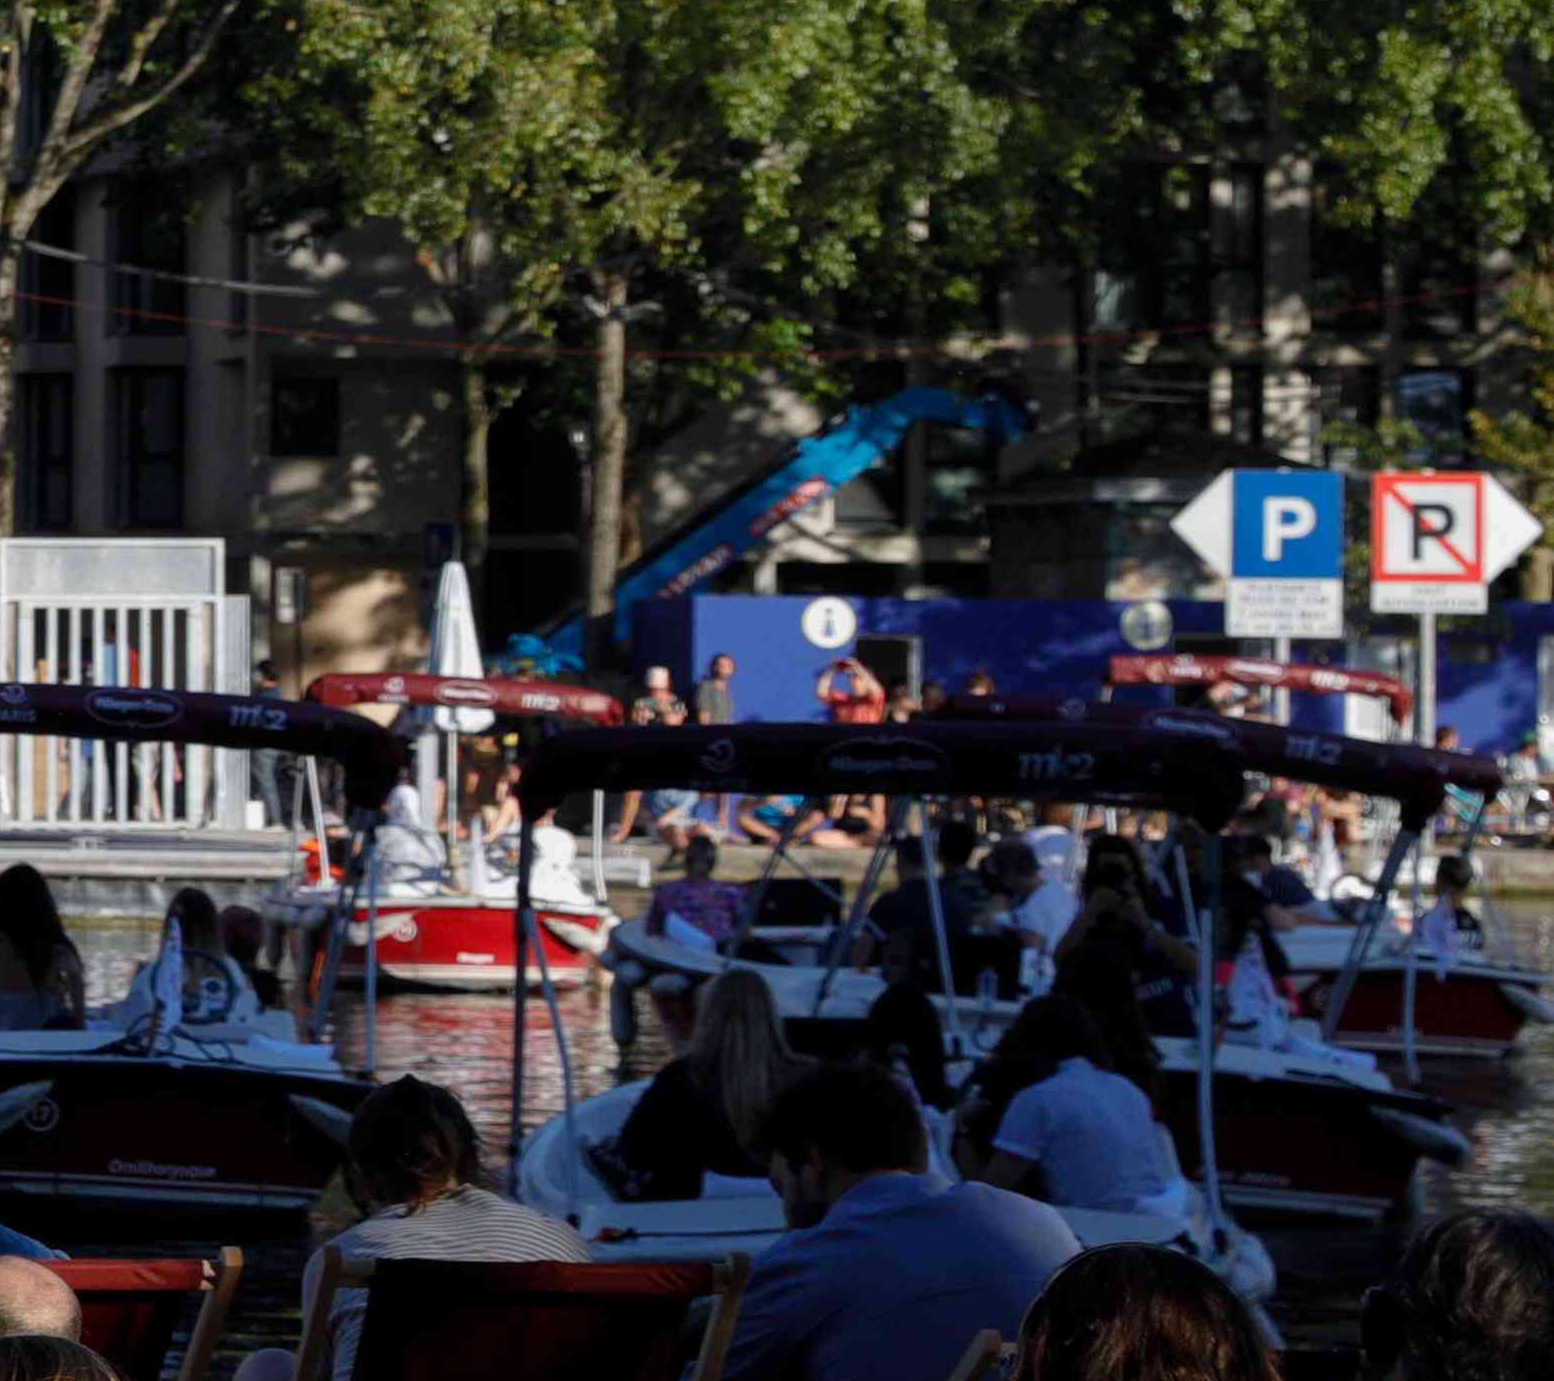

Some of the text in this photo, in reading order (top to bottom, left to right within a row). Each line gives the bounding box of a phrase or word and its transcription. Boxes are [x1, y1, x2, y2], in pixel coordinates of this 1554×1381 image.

[1263, 496, 1317, 562] P
[1411, 504, 1454, 560] P
[228, 705, 289, 730] mk2
[1018, 743, 1099, 780] mk2
